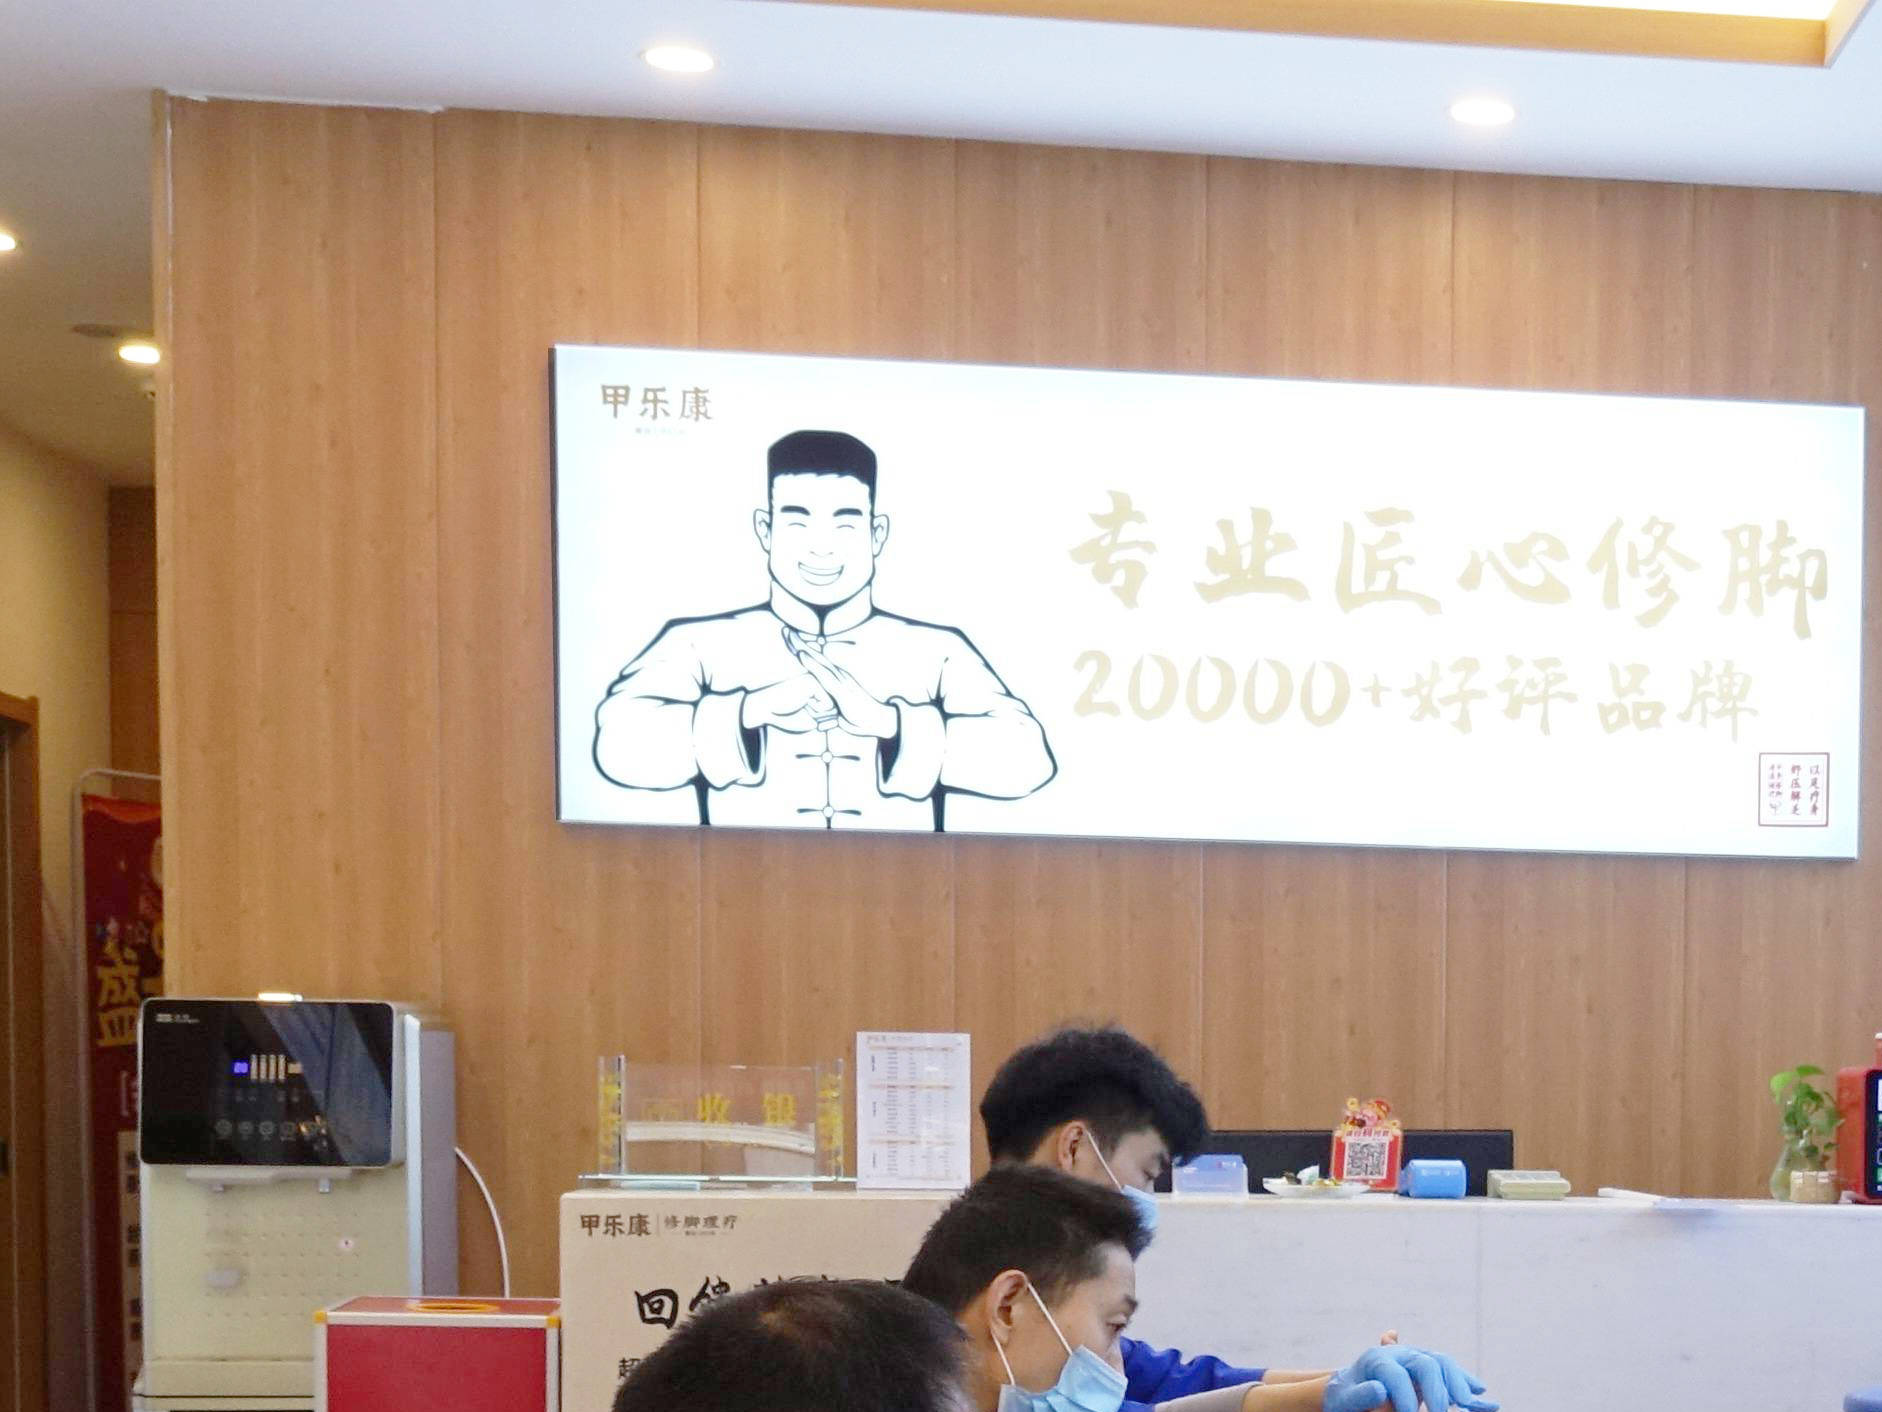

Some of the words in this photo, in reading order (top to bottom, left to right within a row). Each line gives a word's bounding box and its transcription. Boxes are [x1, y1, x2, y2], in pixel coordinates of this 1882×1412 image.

[601, 384, 712, 422] 甲乐康
[1068, 489, 1829, 640] 专业匠心修脚
[1073, 648, 1760, 742] 20000+好评品牌
[580, 1213, 652, 1237] 甲乐康
[664, 1214, 738, 1230] 修脚理疗
